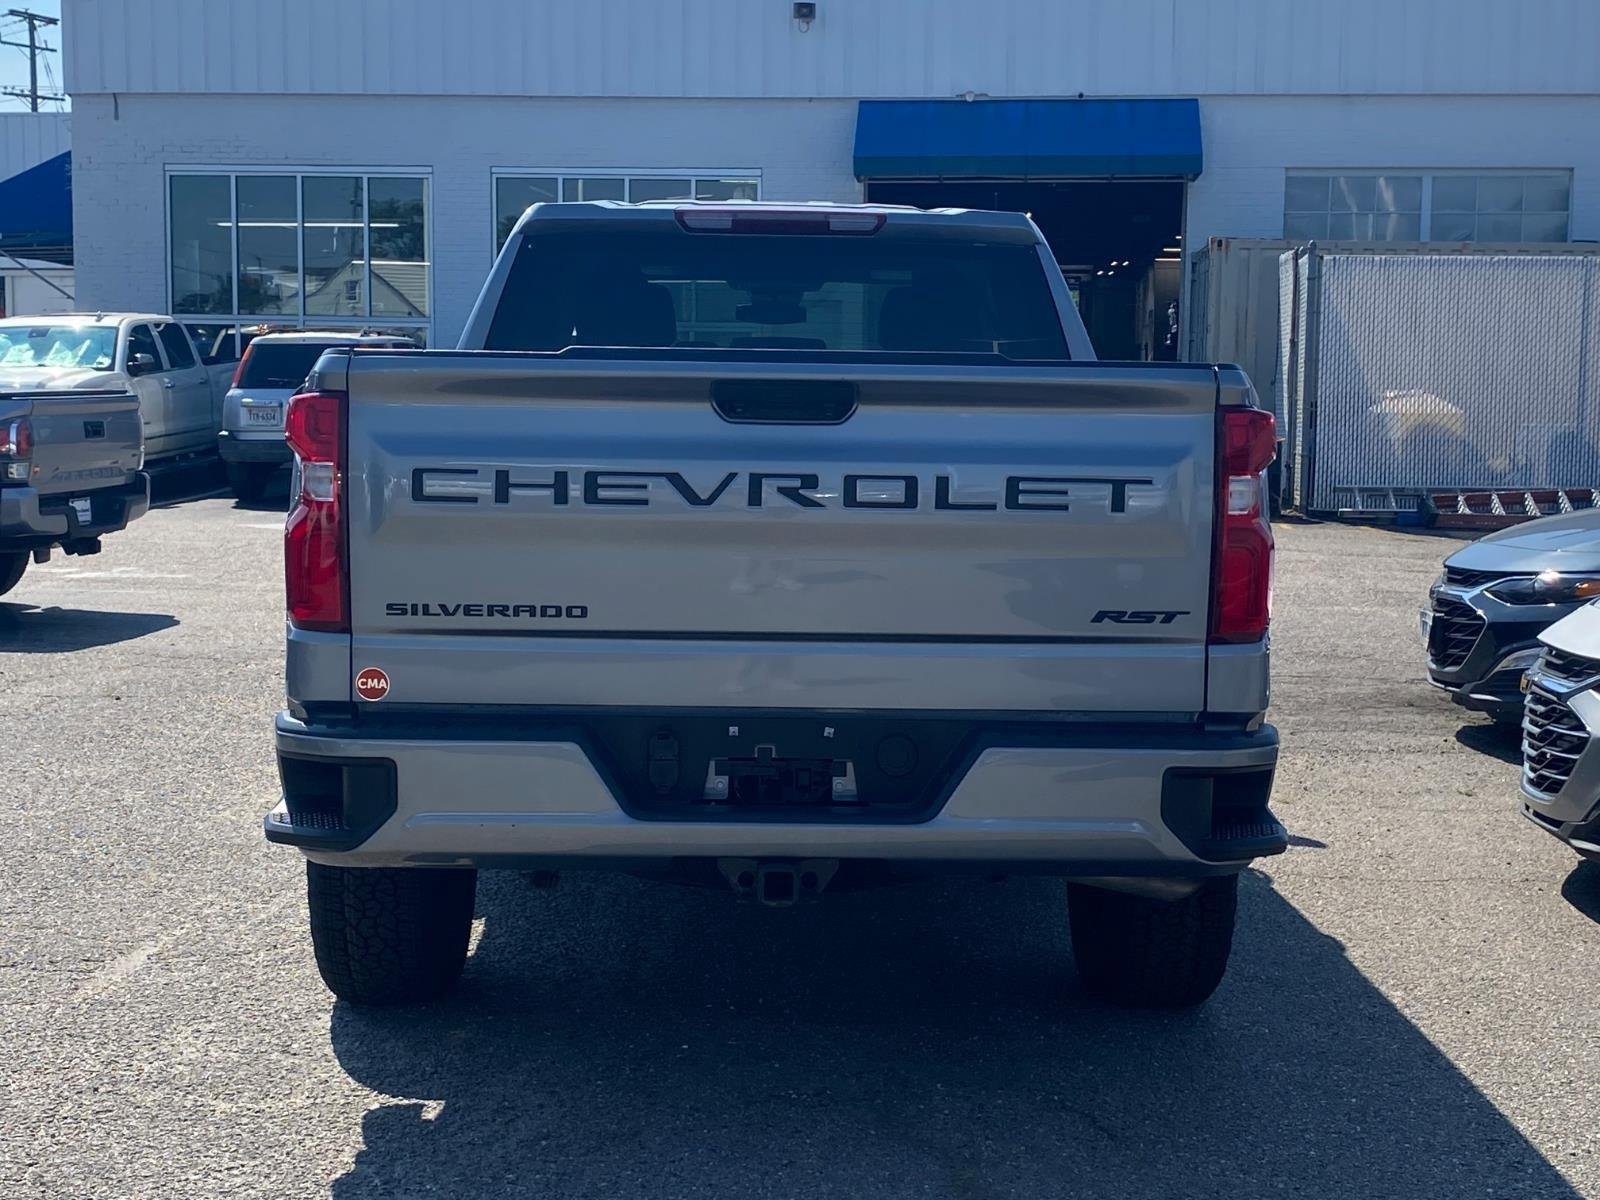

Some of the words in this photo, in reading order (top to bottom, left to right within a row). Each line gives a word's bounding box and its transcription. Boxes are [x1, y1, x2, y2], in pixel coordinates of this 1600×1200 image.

[411, 468, 1153, 513] CHEVROLET
[386, 603, 588, 619] SILVERADO
[1090, 610, 1191, 624] RST
[357, 678, 387, 690] CMA
